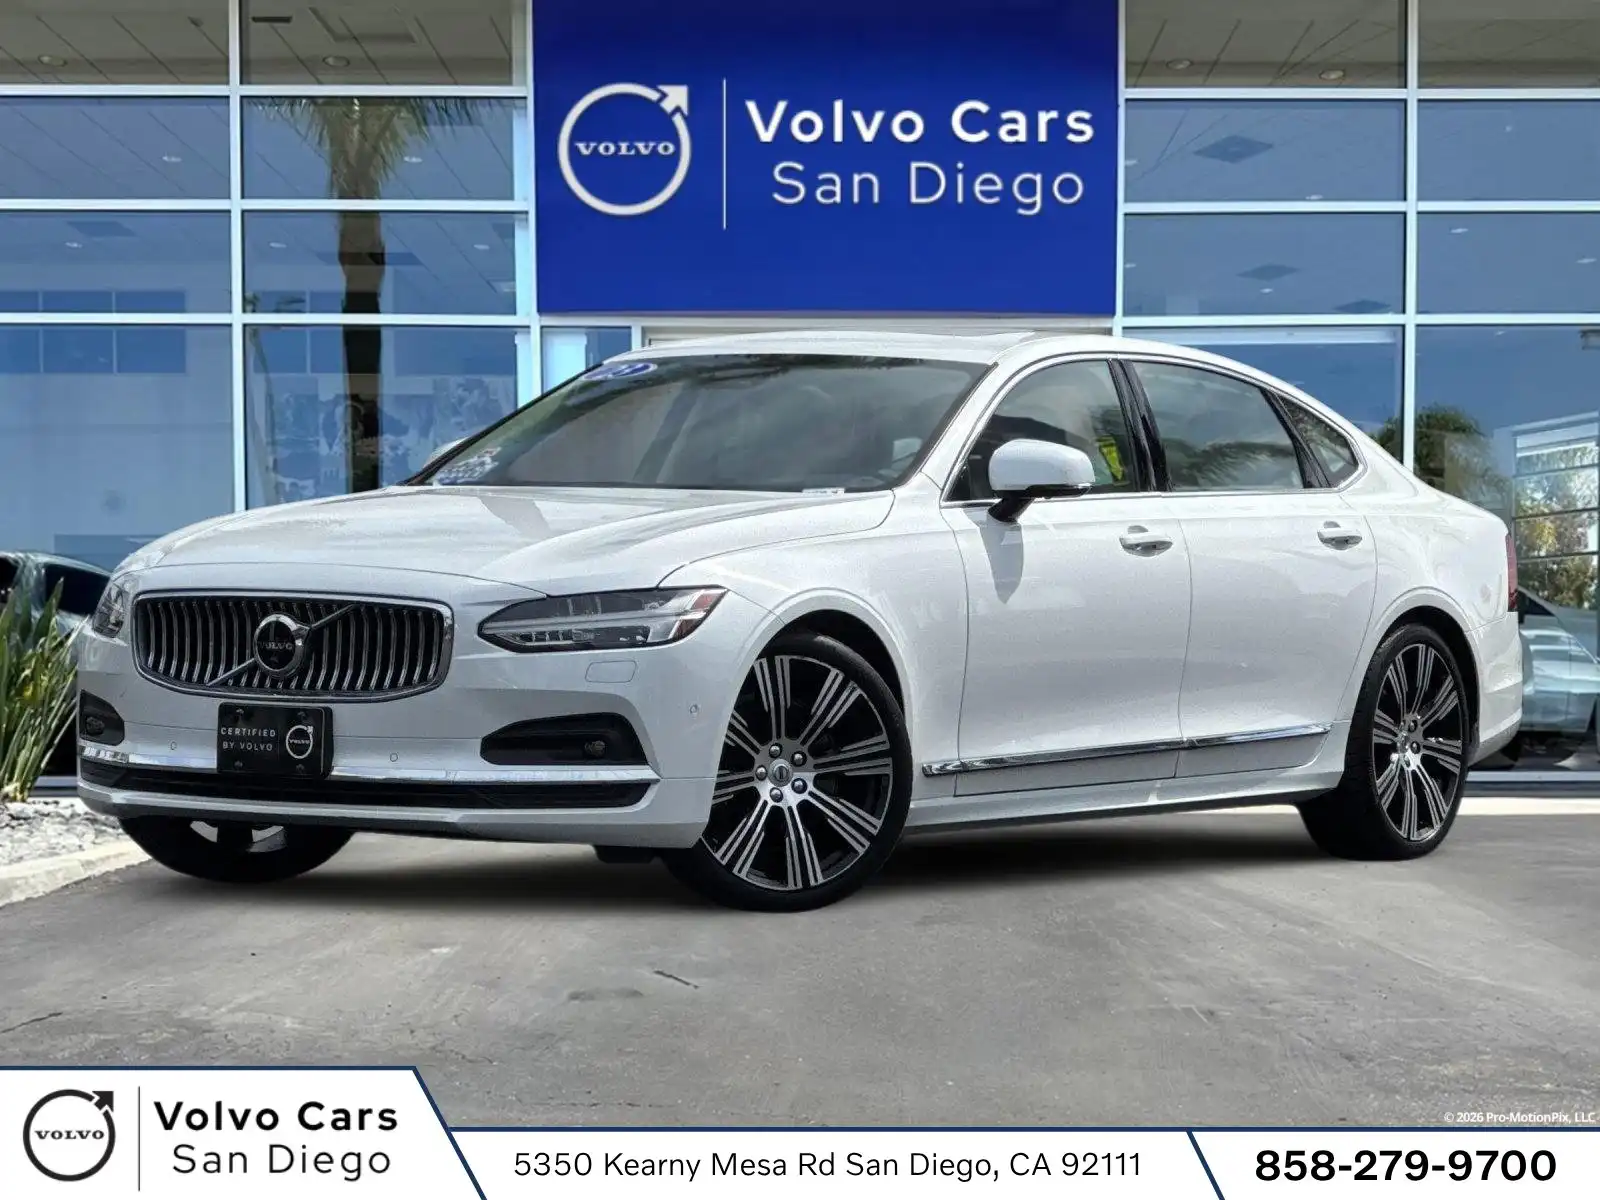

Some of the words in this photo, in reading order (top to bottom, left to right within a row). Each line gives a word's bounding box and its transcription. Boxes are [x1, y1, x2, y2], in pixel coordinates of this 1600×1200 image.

[745, 99, 926, 143] Volvo
[951, 100, 1095, 143] Cars
[575, 141, 676, 156] VOLVO
[773, 161, 880, 204] San
[910, 161, 1084, 216] Diego
[220, 727, 276, 737] CERTIFIED
[222, 741, 235, 749] BY
[239, 742, 273, 752] VOLVO
